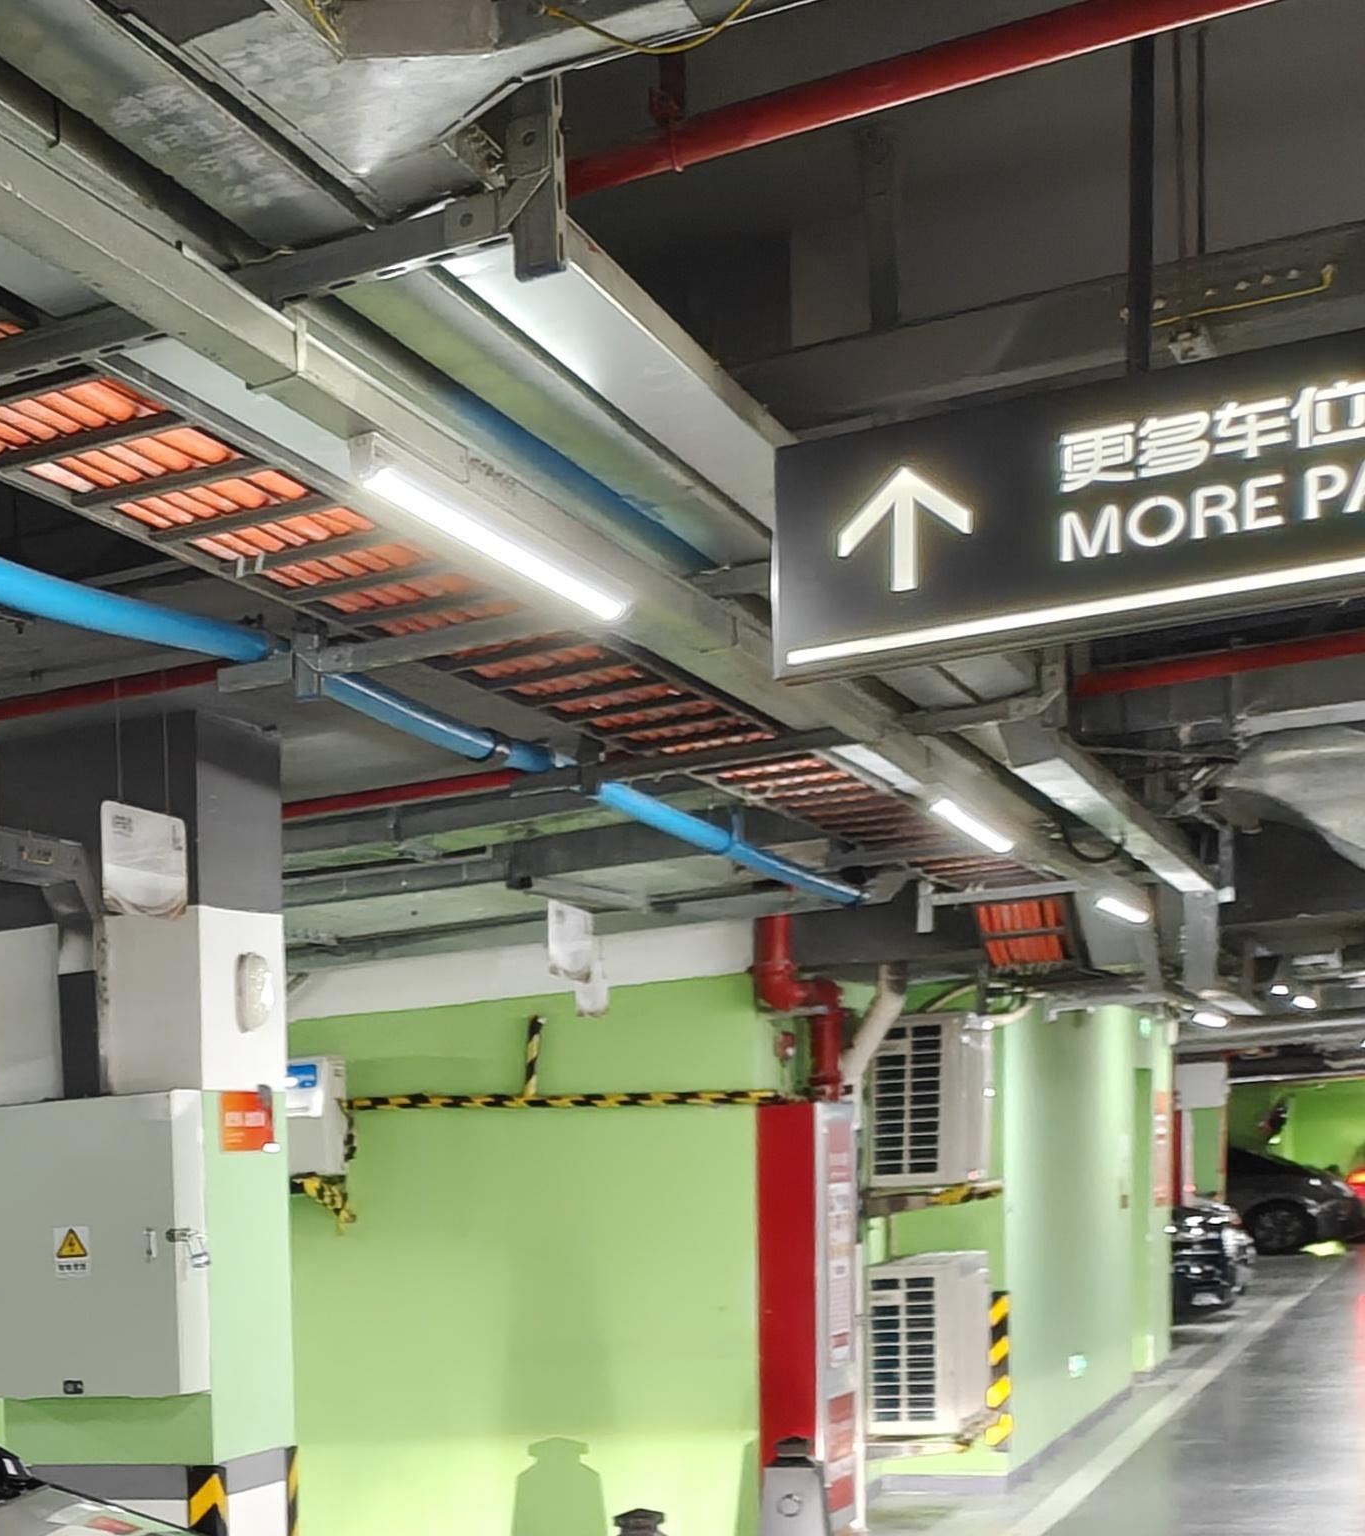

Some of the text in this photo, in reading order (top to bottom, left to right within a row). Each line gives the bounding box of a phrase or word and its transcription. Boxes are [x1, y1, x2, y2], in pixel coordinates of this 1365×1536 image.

[1059, 381, 1365, 493] 更多车位
[1059, 473, 1285, 562] MORE
